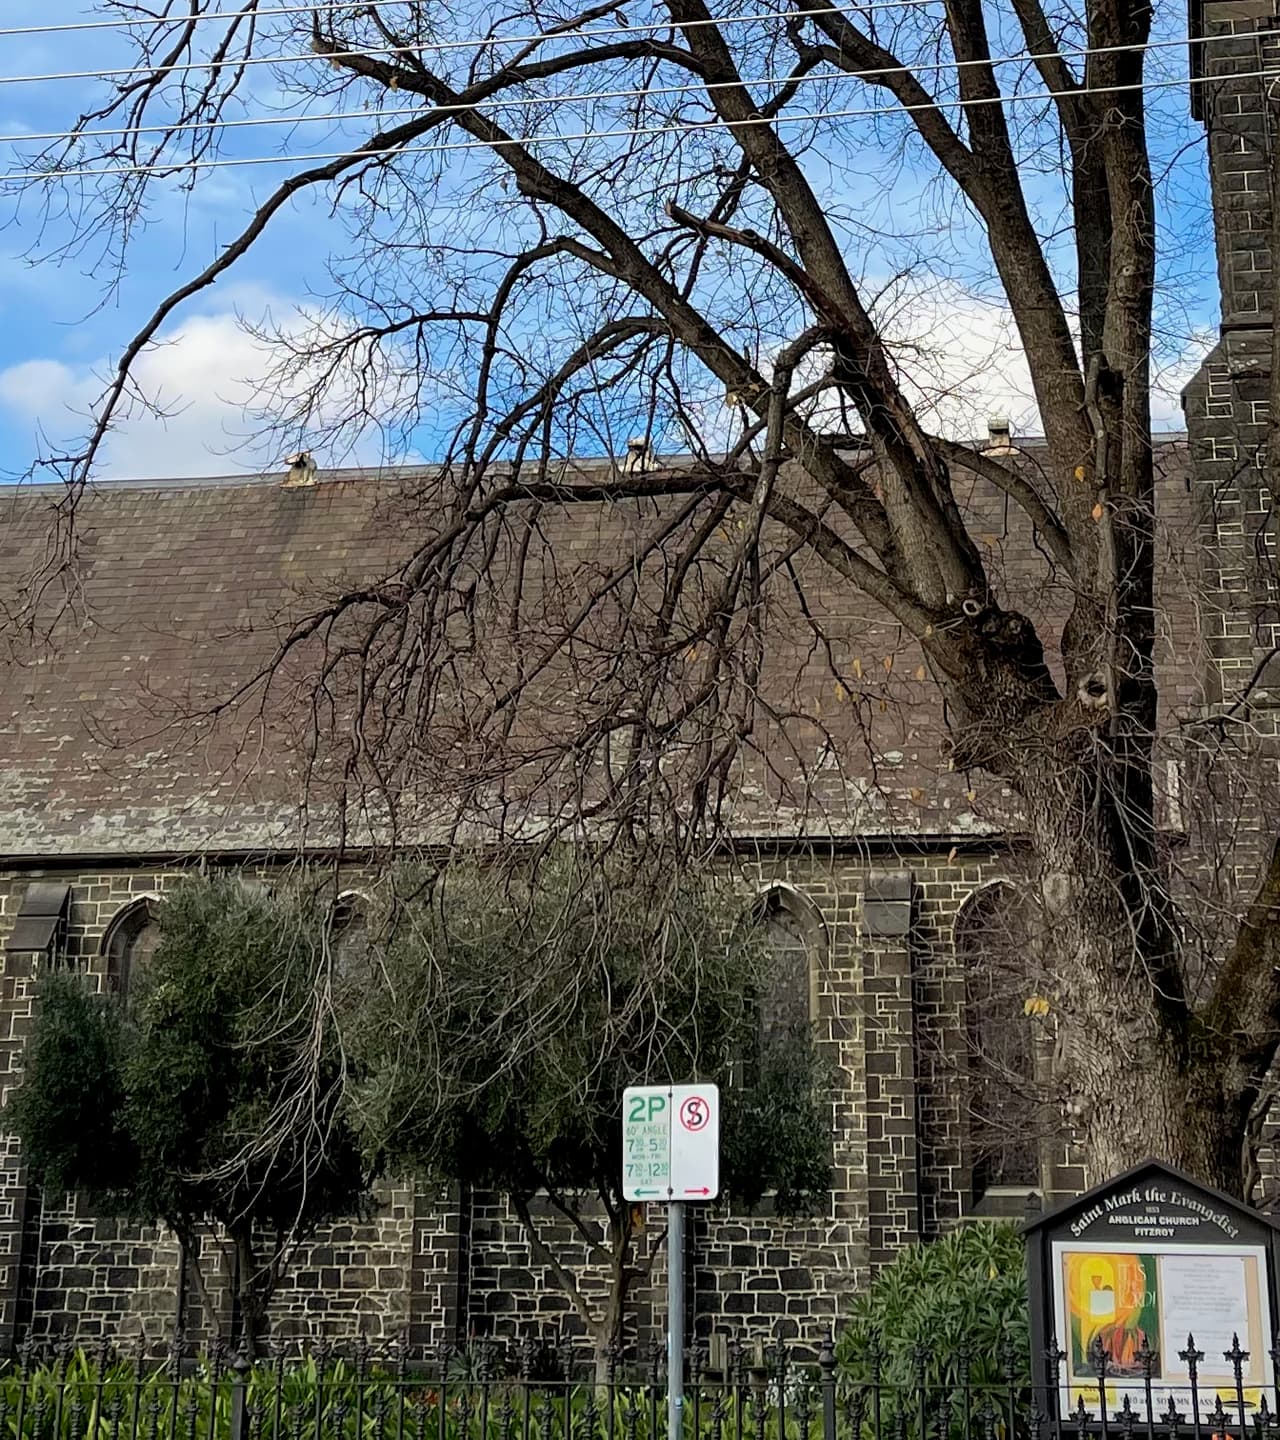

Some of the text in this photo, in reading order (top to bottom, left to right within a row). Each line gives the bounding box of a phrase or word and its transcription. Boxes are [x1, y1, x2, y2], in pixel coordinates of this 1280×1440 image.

[628, 1096, 666, 1122] 2P
[1070, 1187, 1239, 1240] Saint Mark the Evangelist
[1108, 1215, 1200, 1226] ANGLICAN CHURCH
[1134, 1228, 1175, 1237] FITZROY
